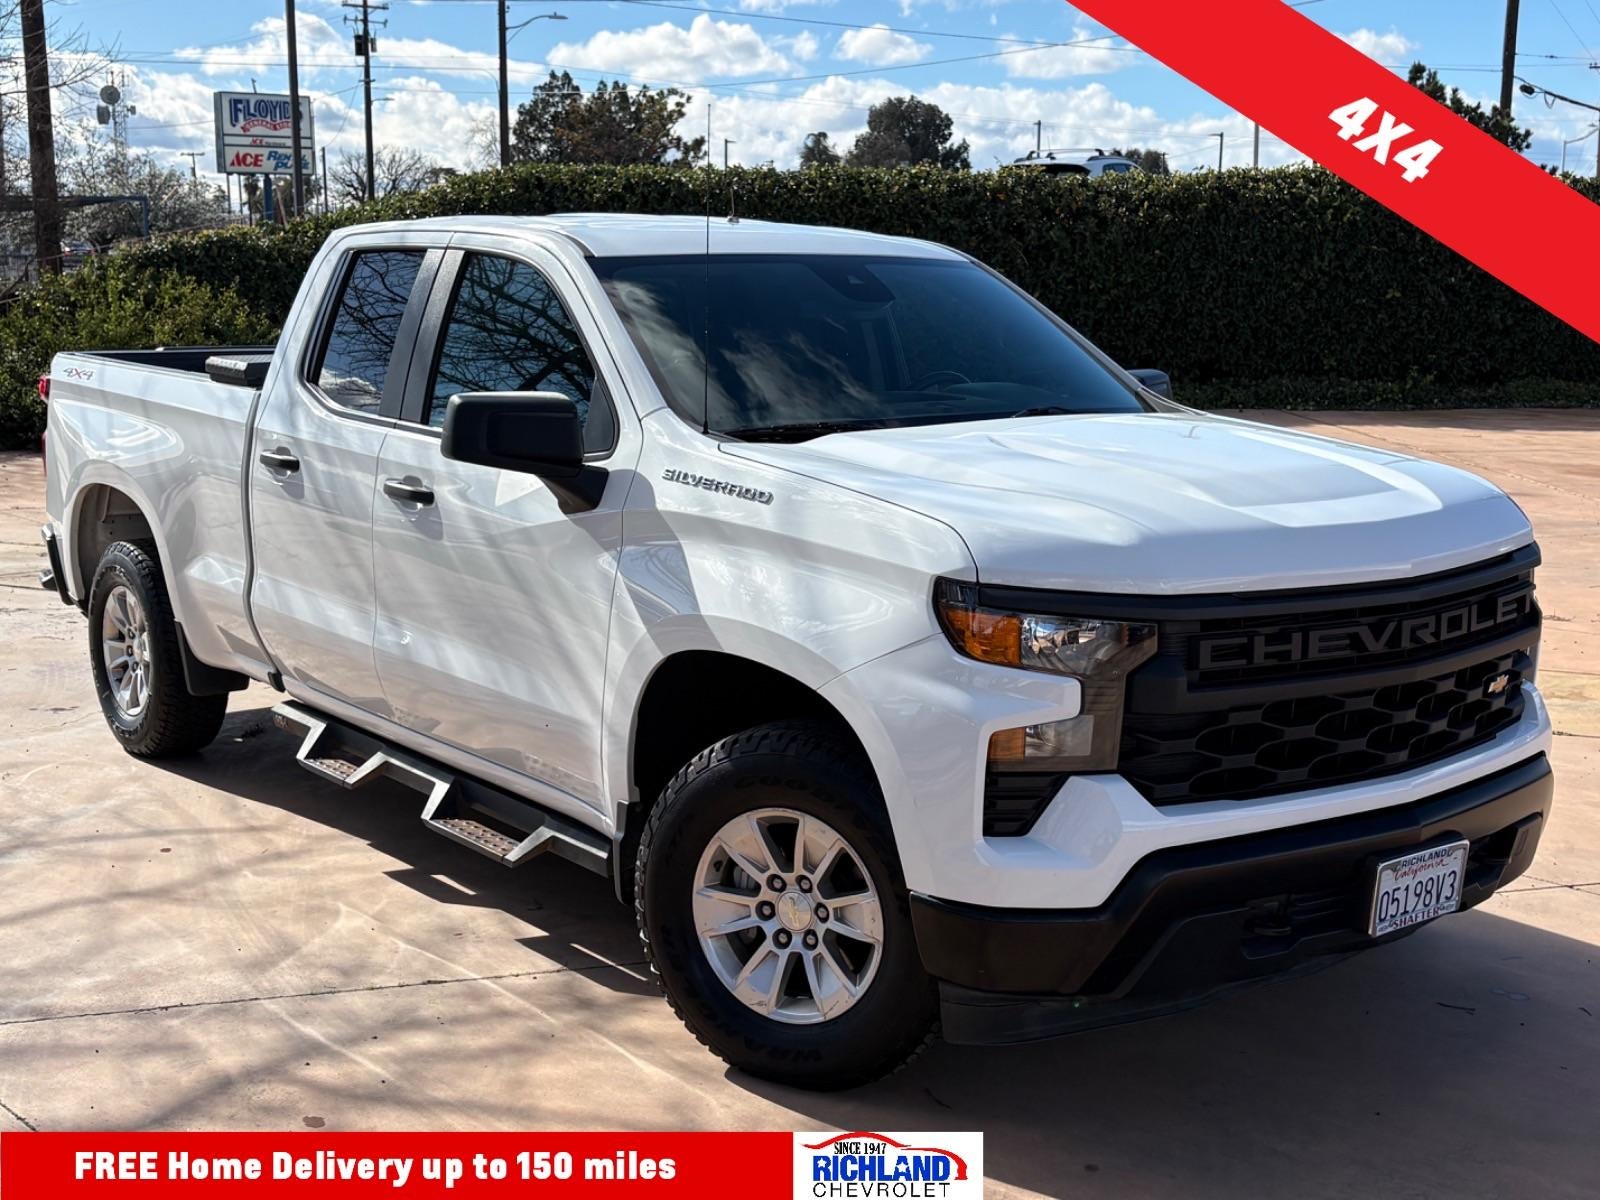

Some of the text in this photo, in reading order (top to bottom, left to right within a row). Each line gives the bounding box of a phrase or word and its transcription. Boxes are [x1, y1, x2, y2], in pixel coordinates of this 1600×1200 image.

[230, 152, 263, 167] ACE
[662, 468, 774, 506] SILVERADO
[1199, 587, 1532, 669] CHEVROLET
[1378, 870, 1457, 922] 05198V3
[1392, 907, 1440, 929] SHAFTER
